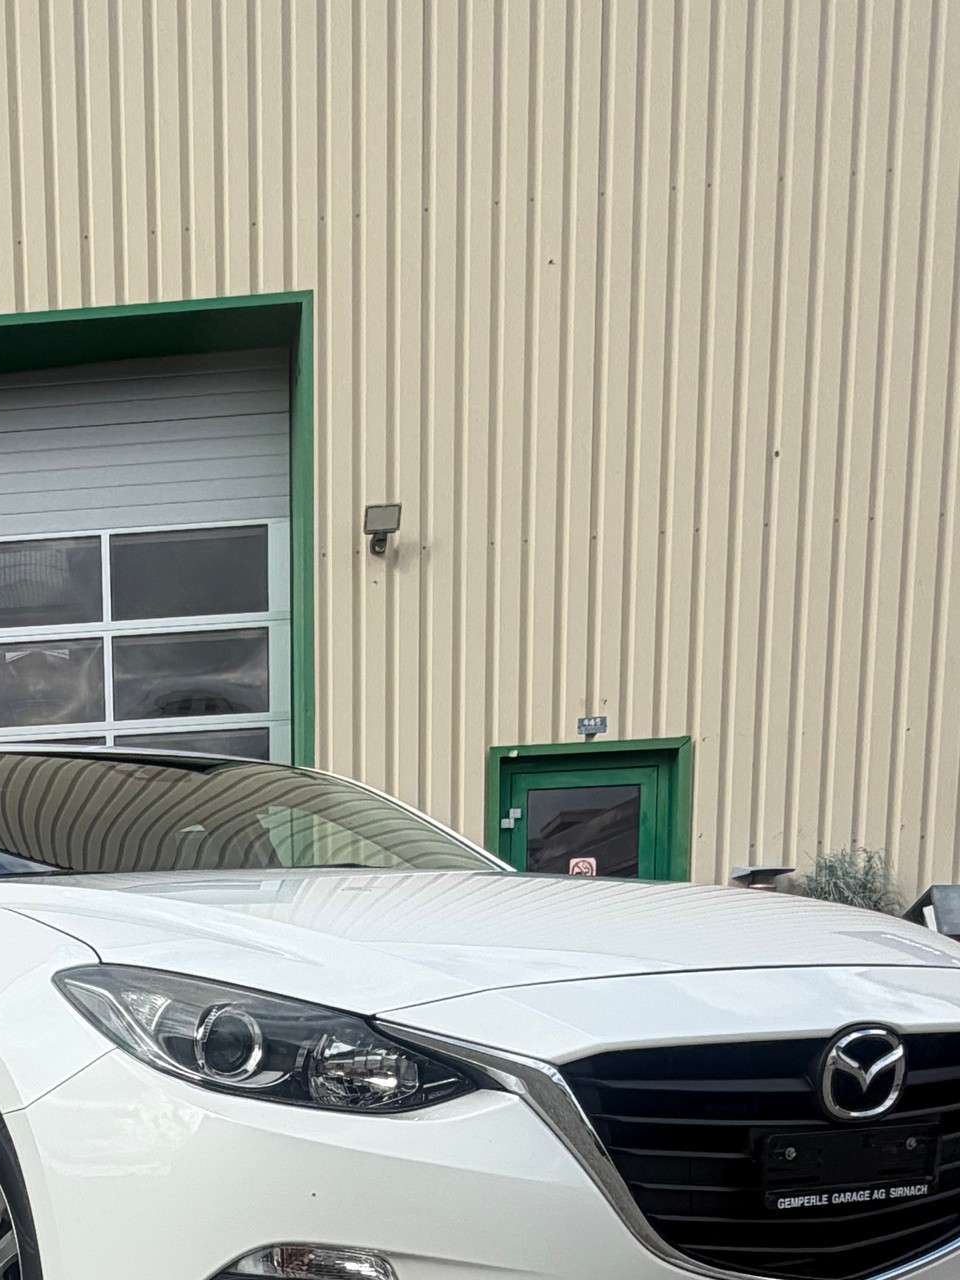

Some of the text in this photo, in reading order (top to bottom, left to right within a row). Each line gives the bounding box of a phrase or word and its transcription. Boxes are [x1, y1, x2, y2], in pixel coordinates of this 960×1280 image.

[777, 1184, 928, 1209] GEMPERLE GARAGE AG SIRNACH
